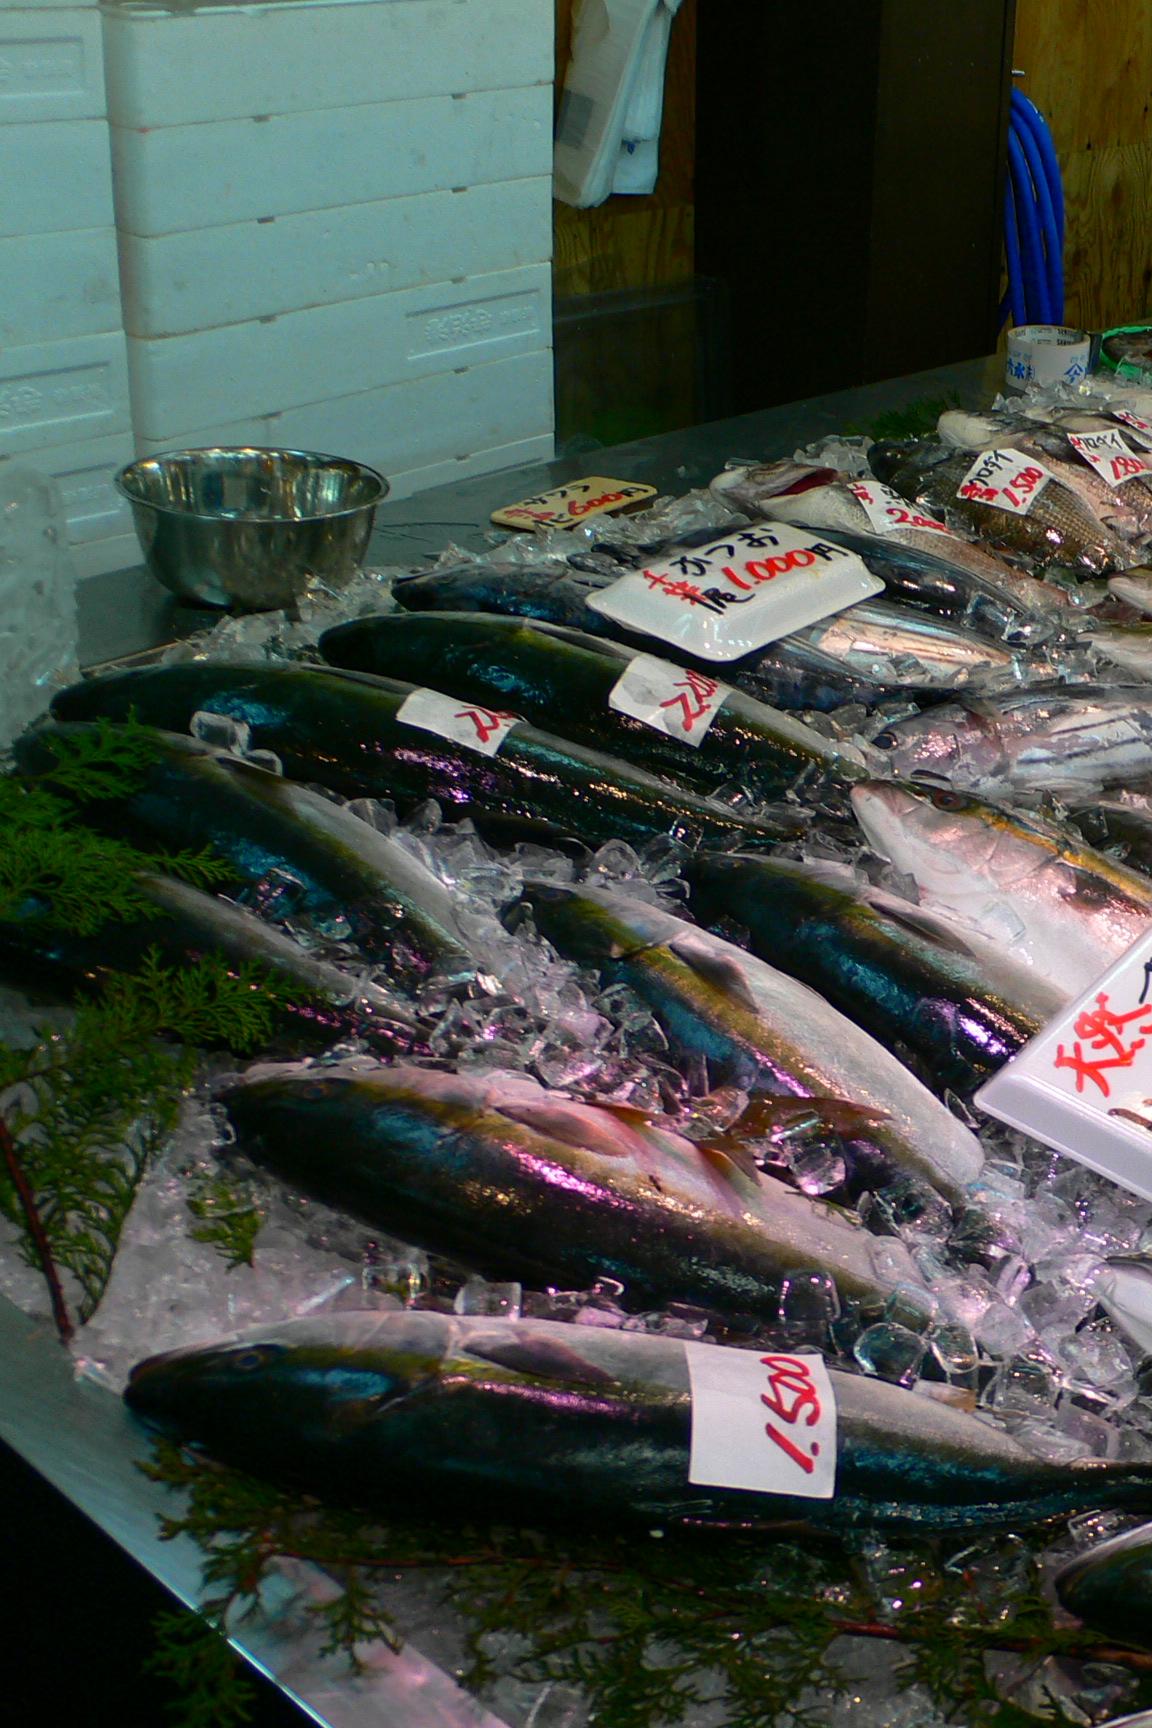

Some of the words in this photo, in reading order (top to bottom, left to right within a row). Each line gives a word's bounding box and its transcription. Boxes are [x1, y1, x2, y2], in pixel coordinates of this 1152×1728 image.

[968, 449, 1014, 487] クロダイ
[1001, 465, 1045, 508] 1.500
[668, 527, 781, 577] かつお
[759, 1355, 822, 1475] 1.500
